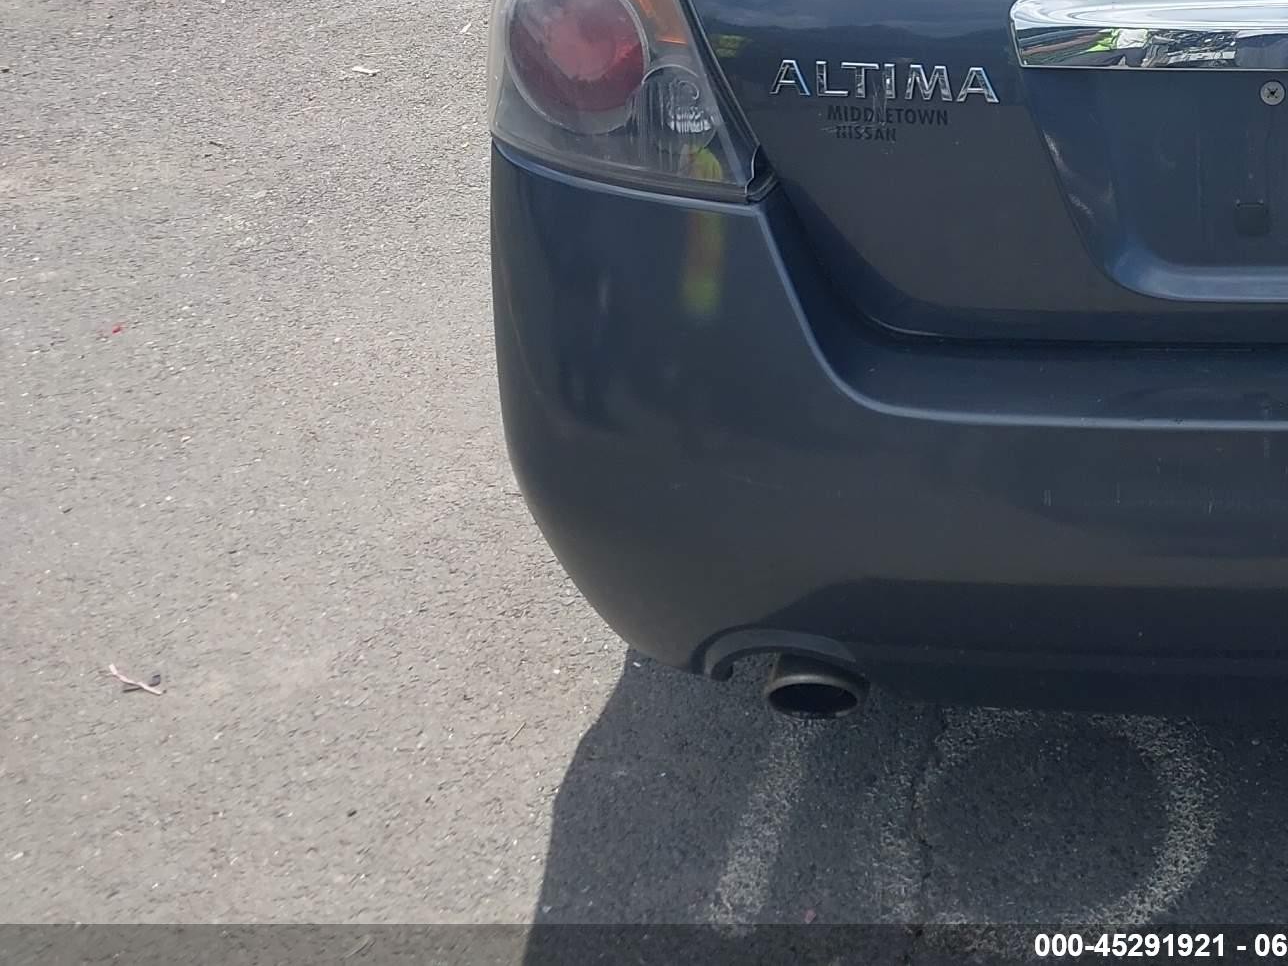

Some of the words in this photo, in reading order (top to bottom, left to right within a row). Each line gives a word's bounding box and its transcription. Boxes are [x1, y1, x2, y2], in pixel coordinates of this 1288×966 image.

[769, 59, 1000, 104] ALTIMA
[827, 105, 948, 126] MIDDLETOWN
[835, 126, 897, 142] NISSAN
